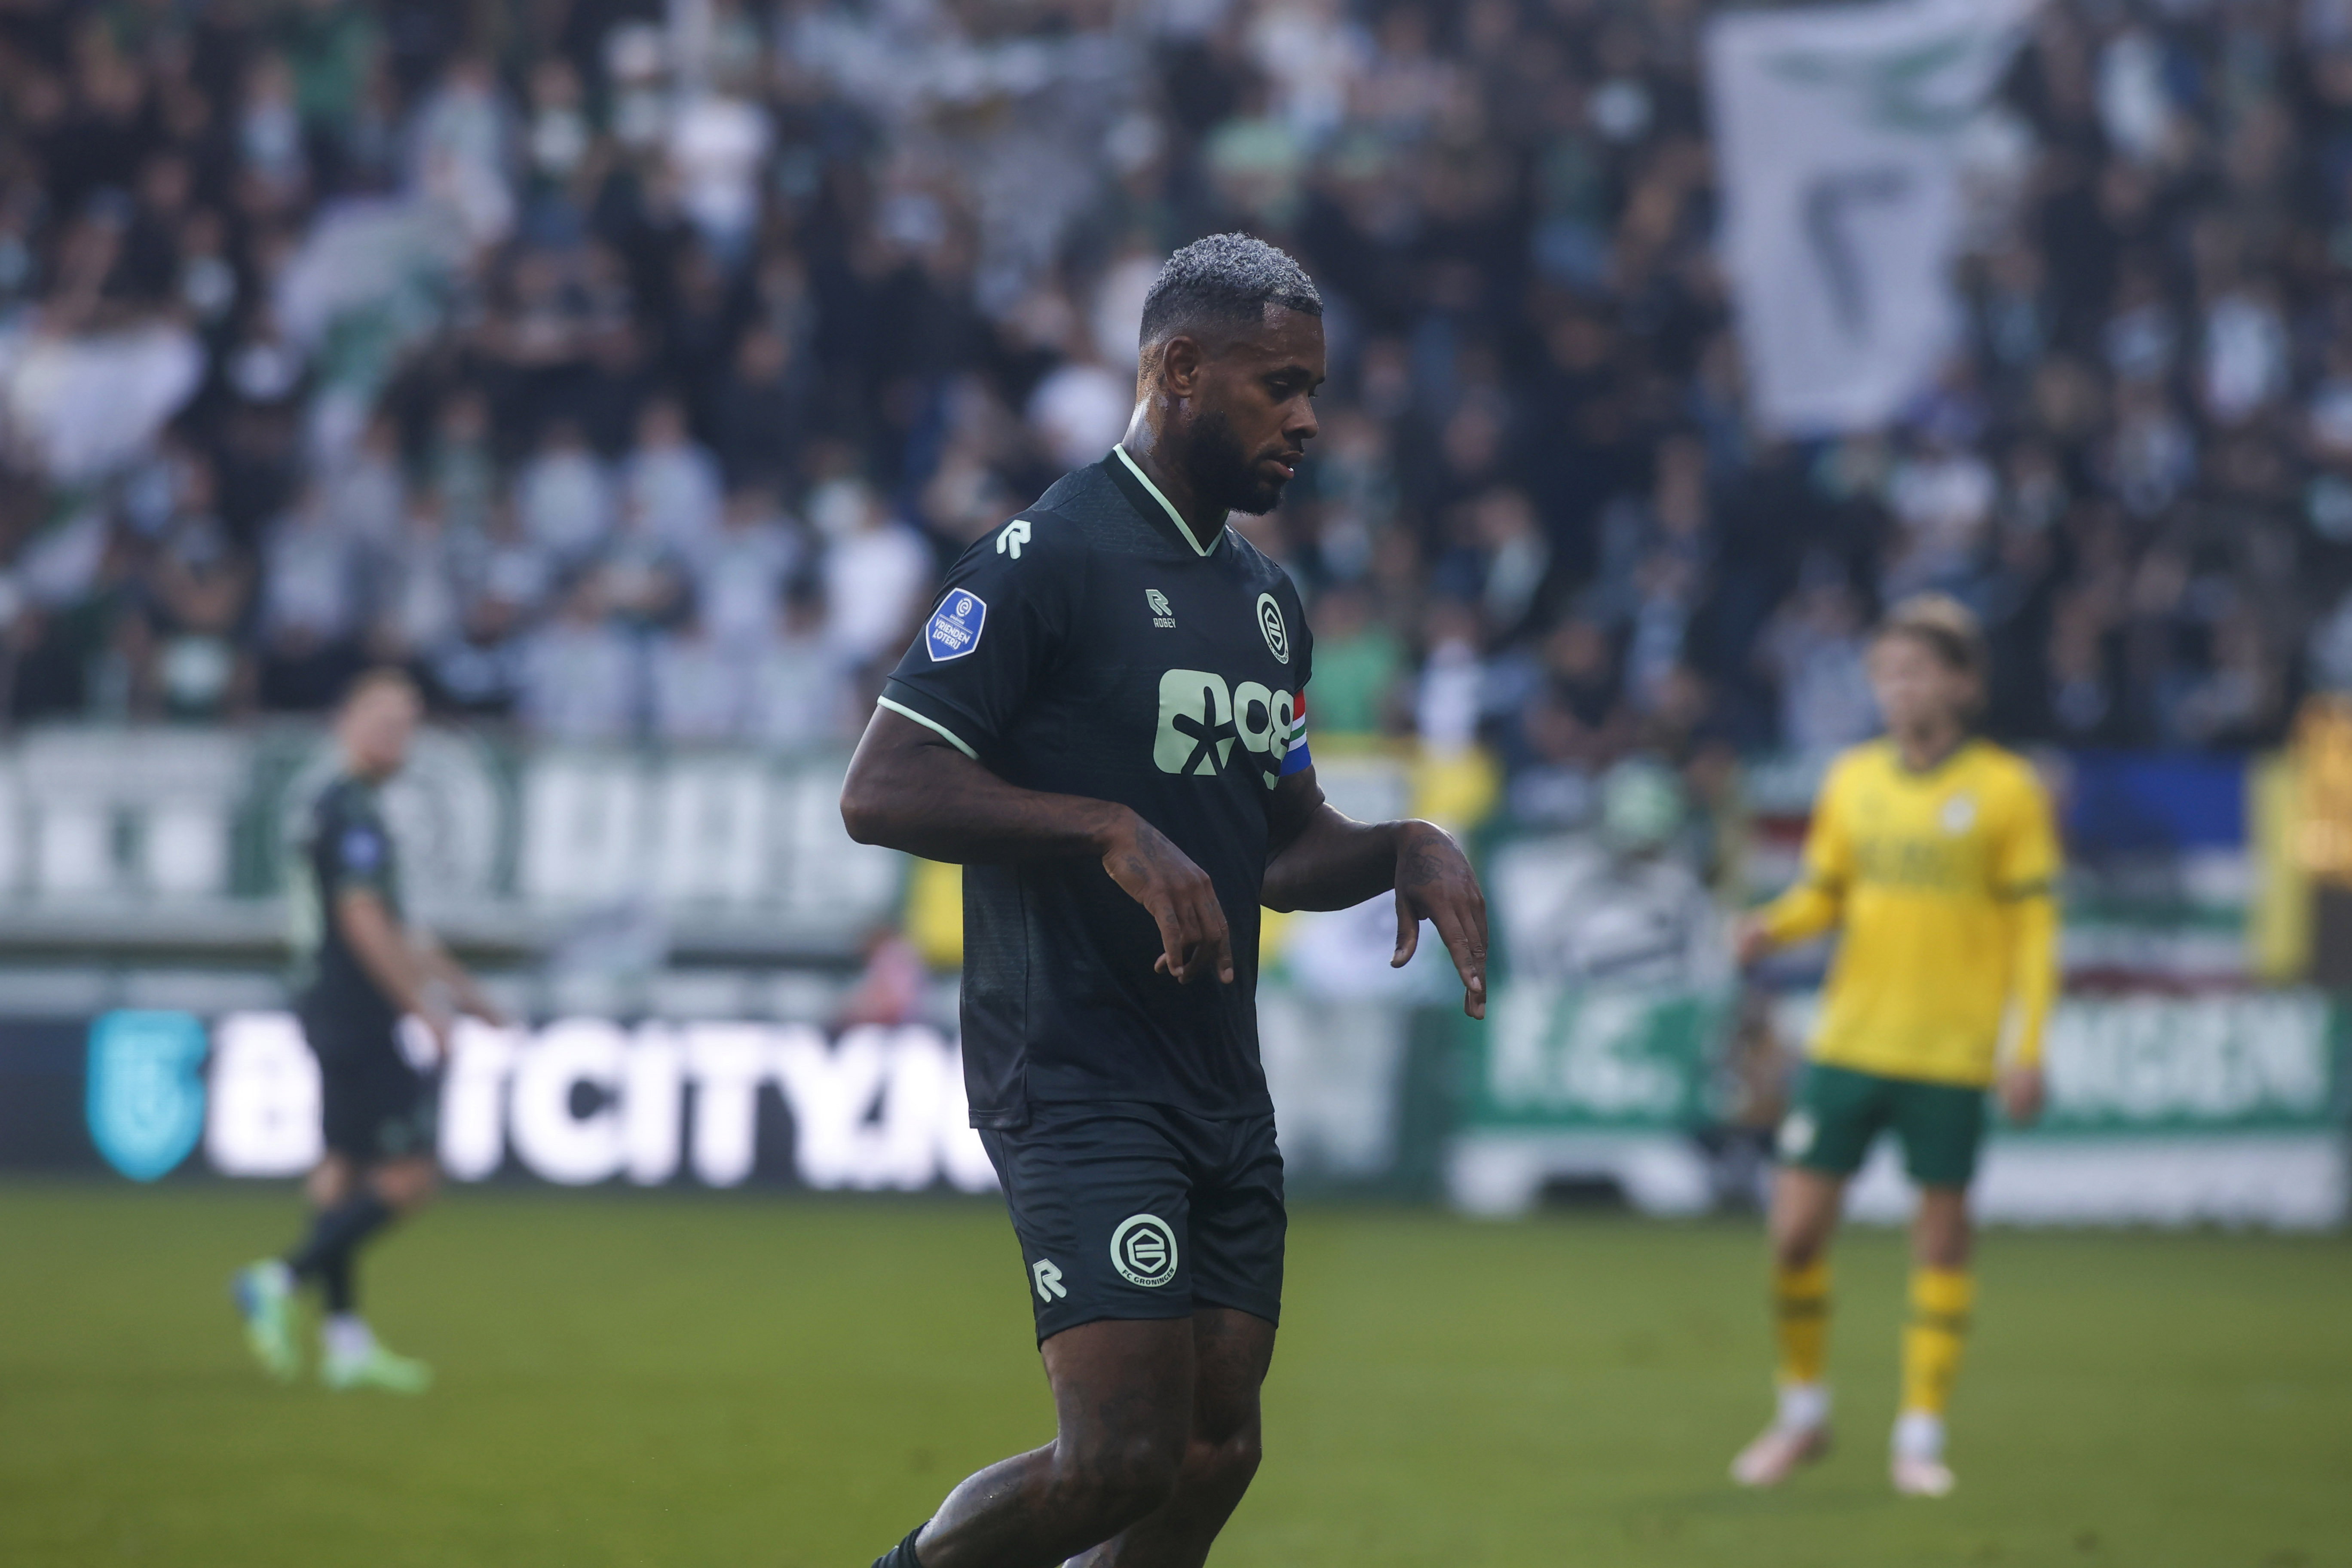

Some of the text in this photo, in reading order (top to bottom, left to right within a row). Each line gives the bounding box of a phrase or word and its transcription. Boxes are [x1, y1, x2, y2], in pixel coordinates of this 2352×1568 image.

[934, 618, 971, 644] VRIENDEN
[1153, 618, 1176, 628] ROBEY
[1122, 1267, 1174, 1286] FC GRONINGEN
